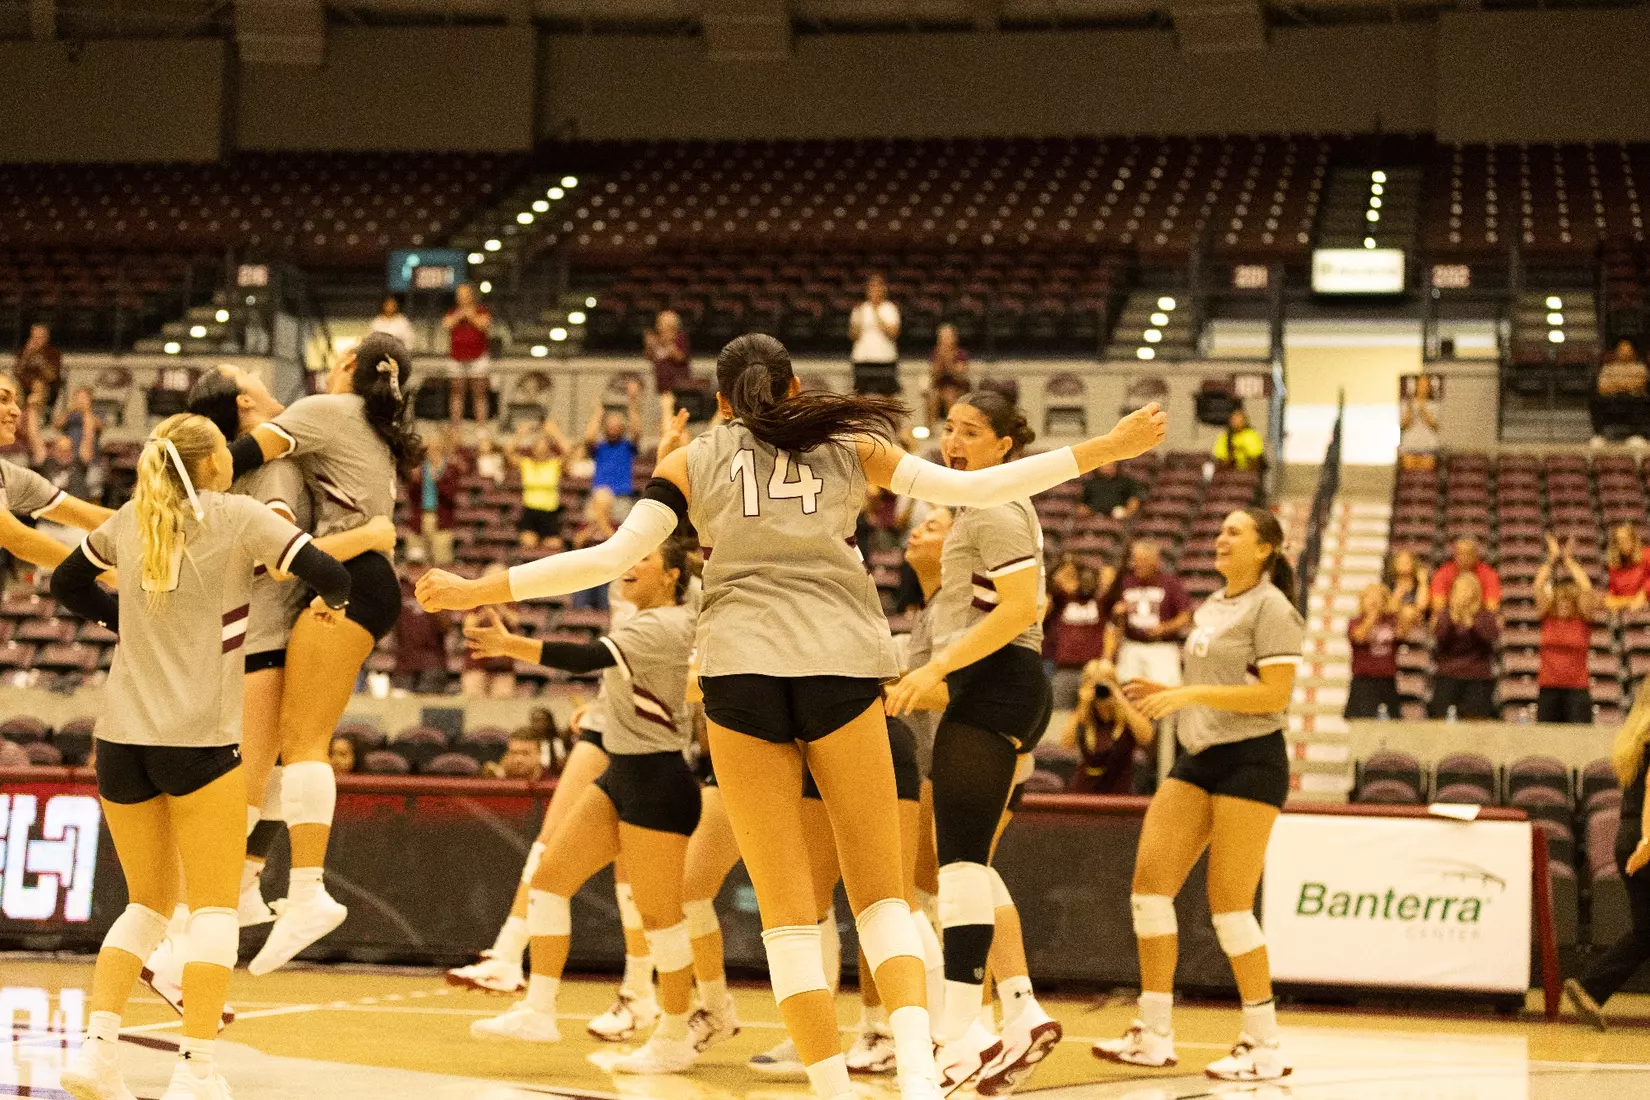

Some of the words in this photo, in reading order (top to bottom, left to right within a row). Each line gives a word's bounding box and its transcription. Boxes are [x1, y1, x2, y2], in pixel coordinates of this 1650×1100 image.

[730, 447, 824, 517] 14
[1296, 881, 1482, 923] Banterra
[1404, 926, 1481, 940] CENTER
